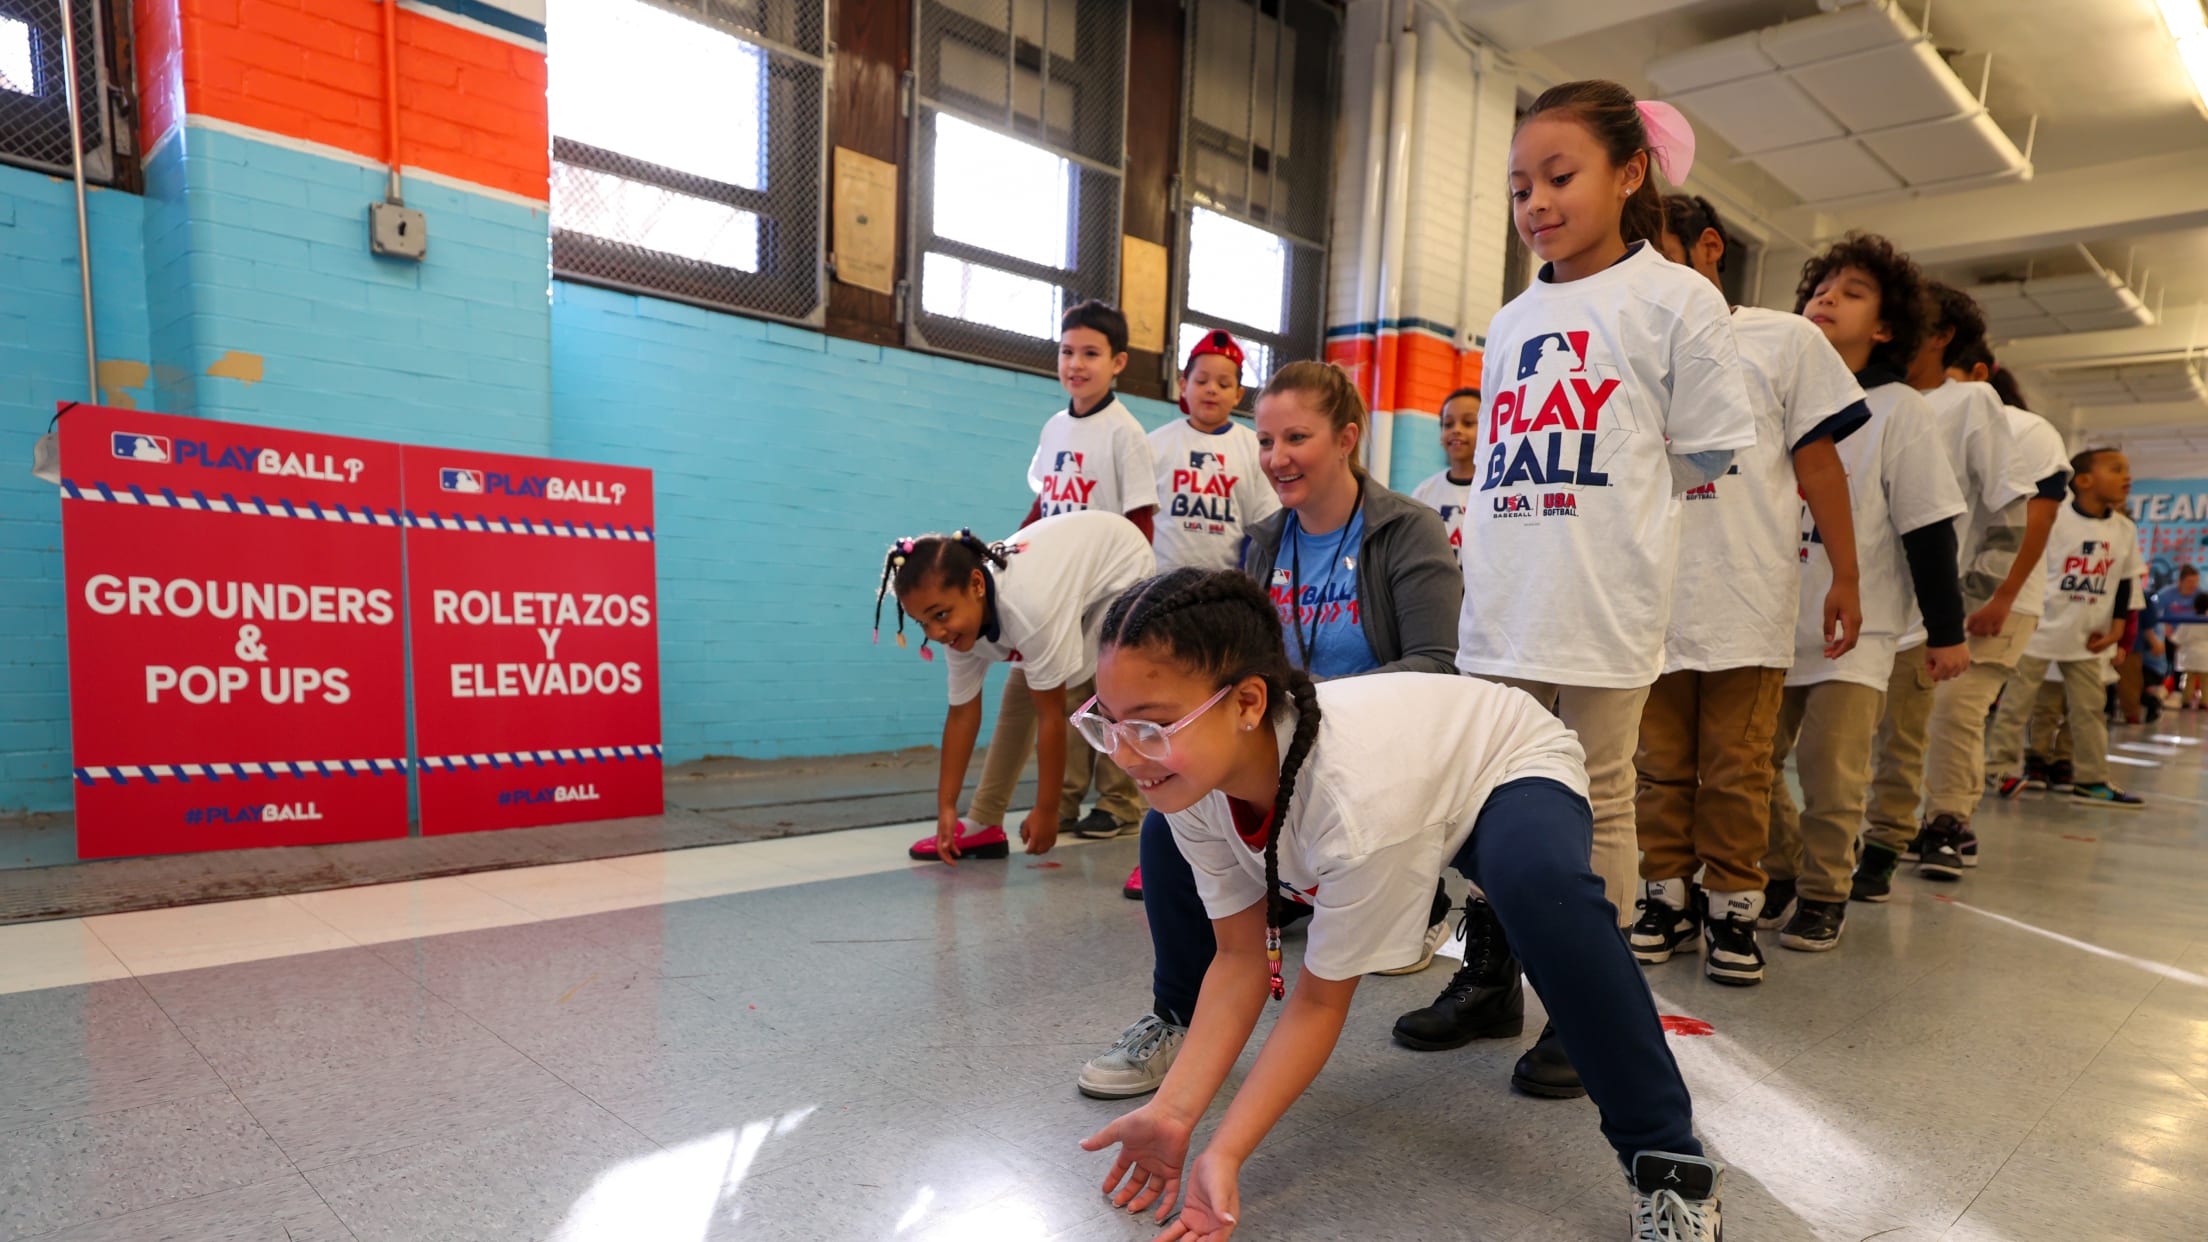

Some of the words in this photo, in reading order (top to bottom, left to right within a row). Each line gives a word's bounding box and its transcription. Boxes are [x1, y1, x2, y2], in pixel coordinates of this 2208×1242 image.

[1488, 377, 1622, 445] PLAY
[1479, 431, 1609, 492] BALL
[1043, 474, 1097, 504] PLAY
[1173, 469, 1239, 498] PLAY
[1042, 502, 1088, 517] BA
[1171, 493, 1235, 522] BALL
[1493, 495, 1531, 512] USA
[1543, 492, 1576, 509] USA
[1543, 508, 1577, 517] SOFTBALL
[2064, 556, 2115, 576] PLAY
[84, 573, 393, 625] GROUNDERS
[2060, 574, 2107, 595] BALL
[433, 589, 650, 627] ROLETAZOS
[234, 624, 269, 662] &
[537, 627, 562, 660] Y
[145, 664, 249, 705] POP
[259, 667, 351, 705] UPS
[450, 661, 642, 698] ELEVADOS
[496, 783, 600, 806] #PLAYBALL
[185, 801, 322, 824] #PLAYBALL
[1728, 899, 1749, 910] PUMA
